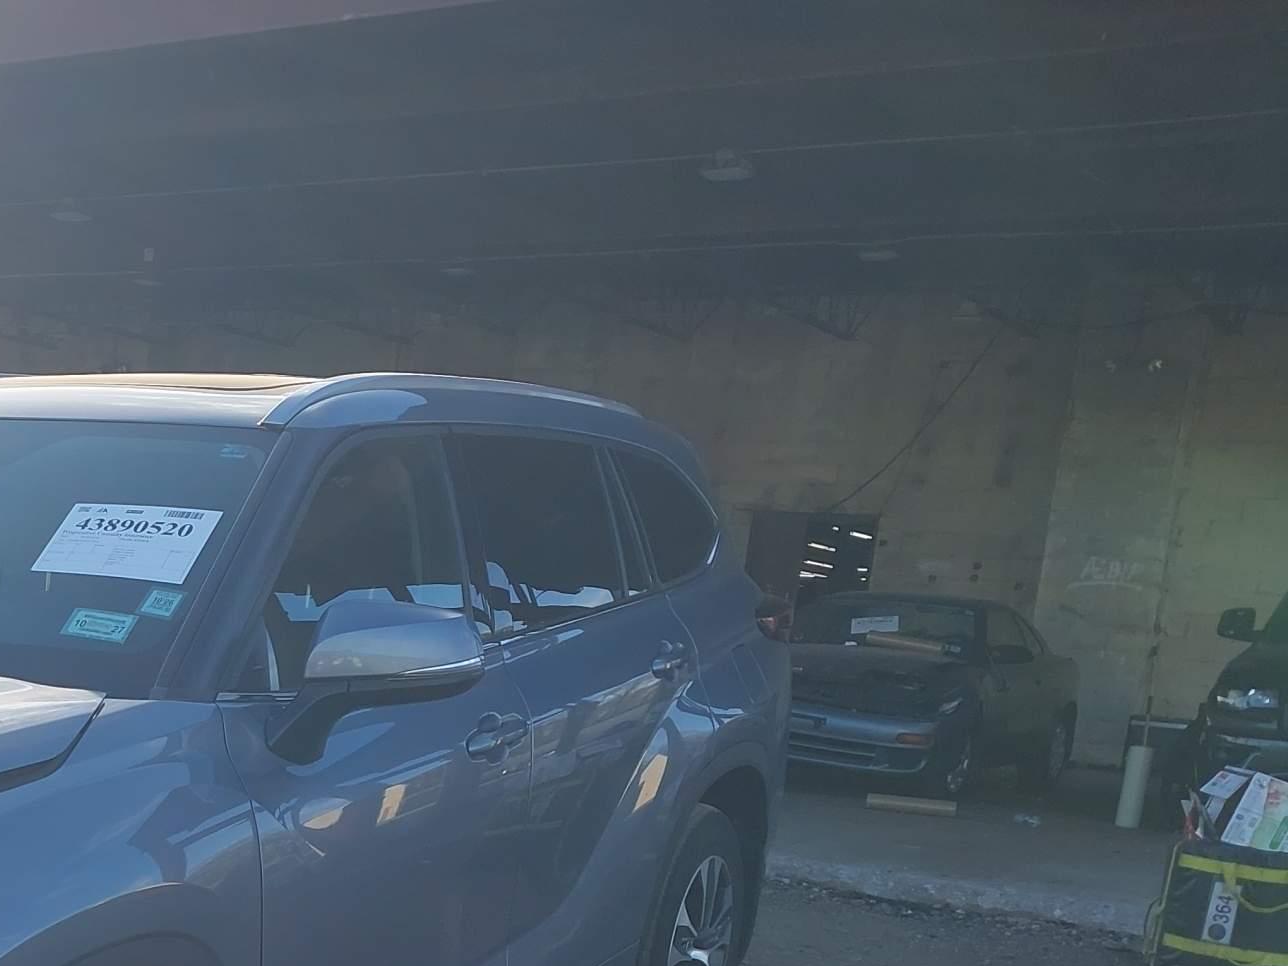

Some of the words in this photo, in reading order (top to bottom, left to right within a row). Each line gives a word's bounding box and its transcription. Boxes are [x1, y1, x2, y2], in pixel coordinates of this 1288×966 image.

[75, 517, 194, 537] 43890520
[74, 618, 87, 628] 10
[110, 624, 126, 634] 27
[1212, 895, 1232, 924] 364
